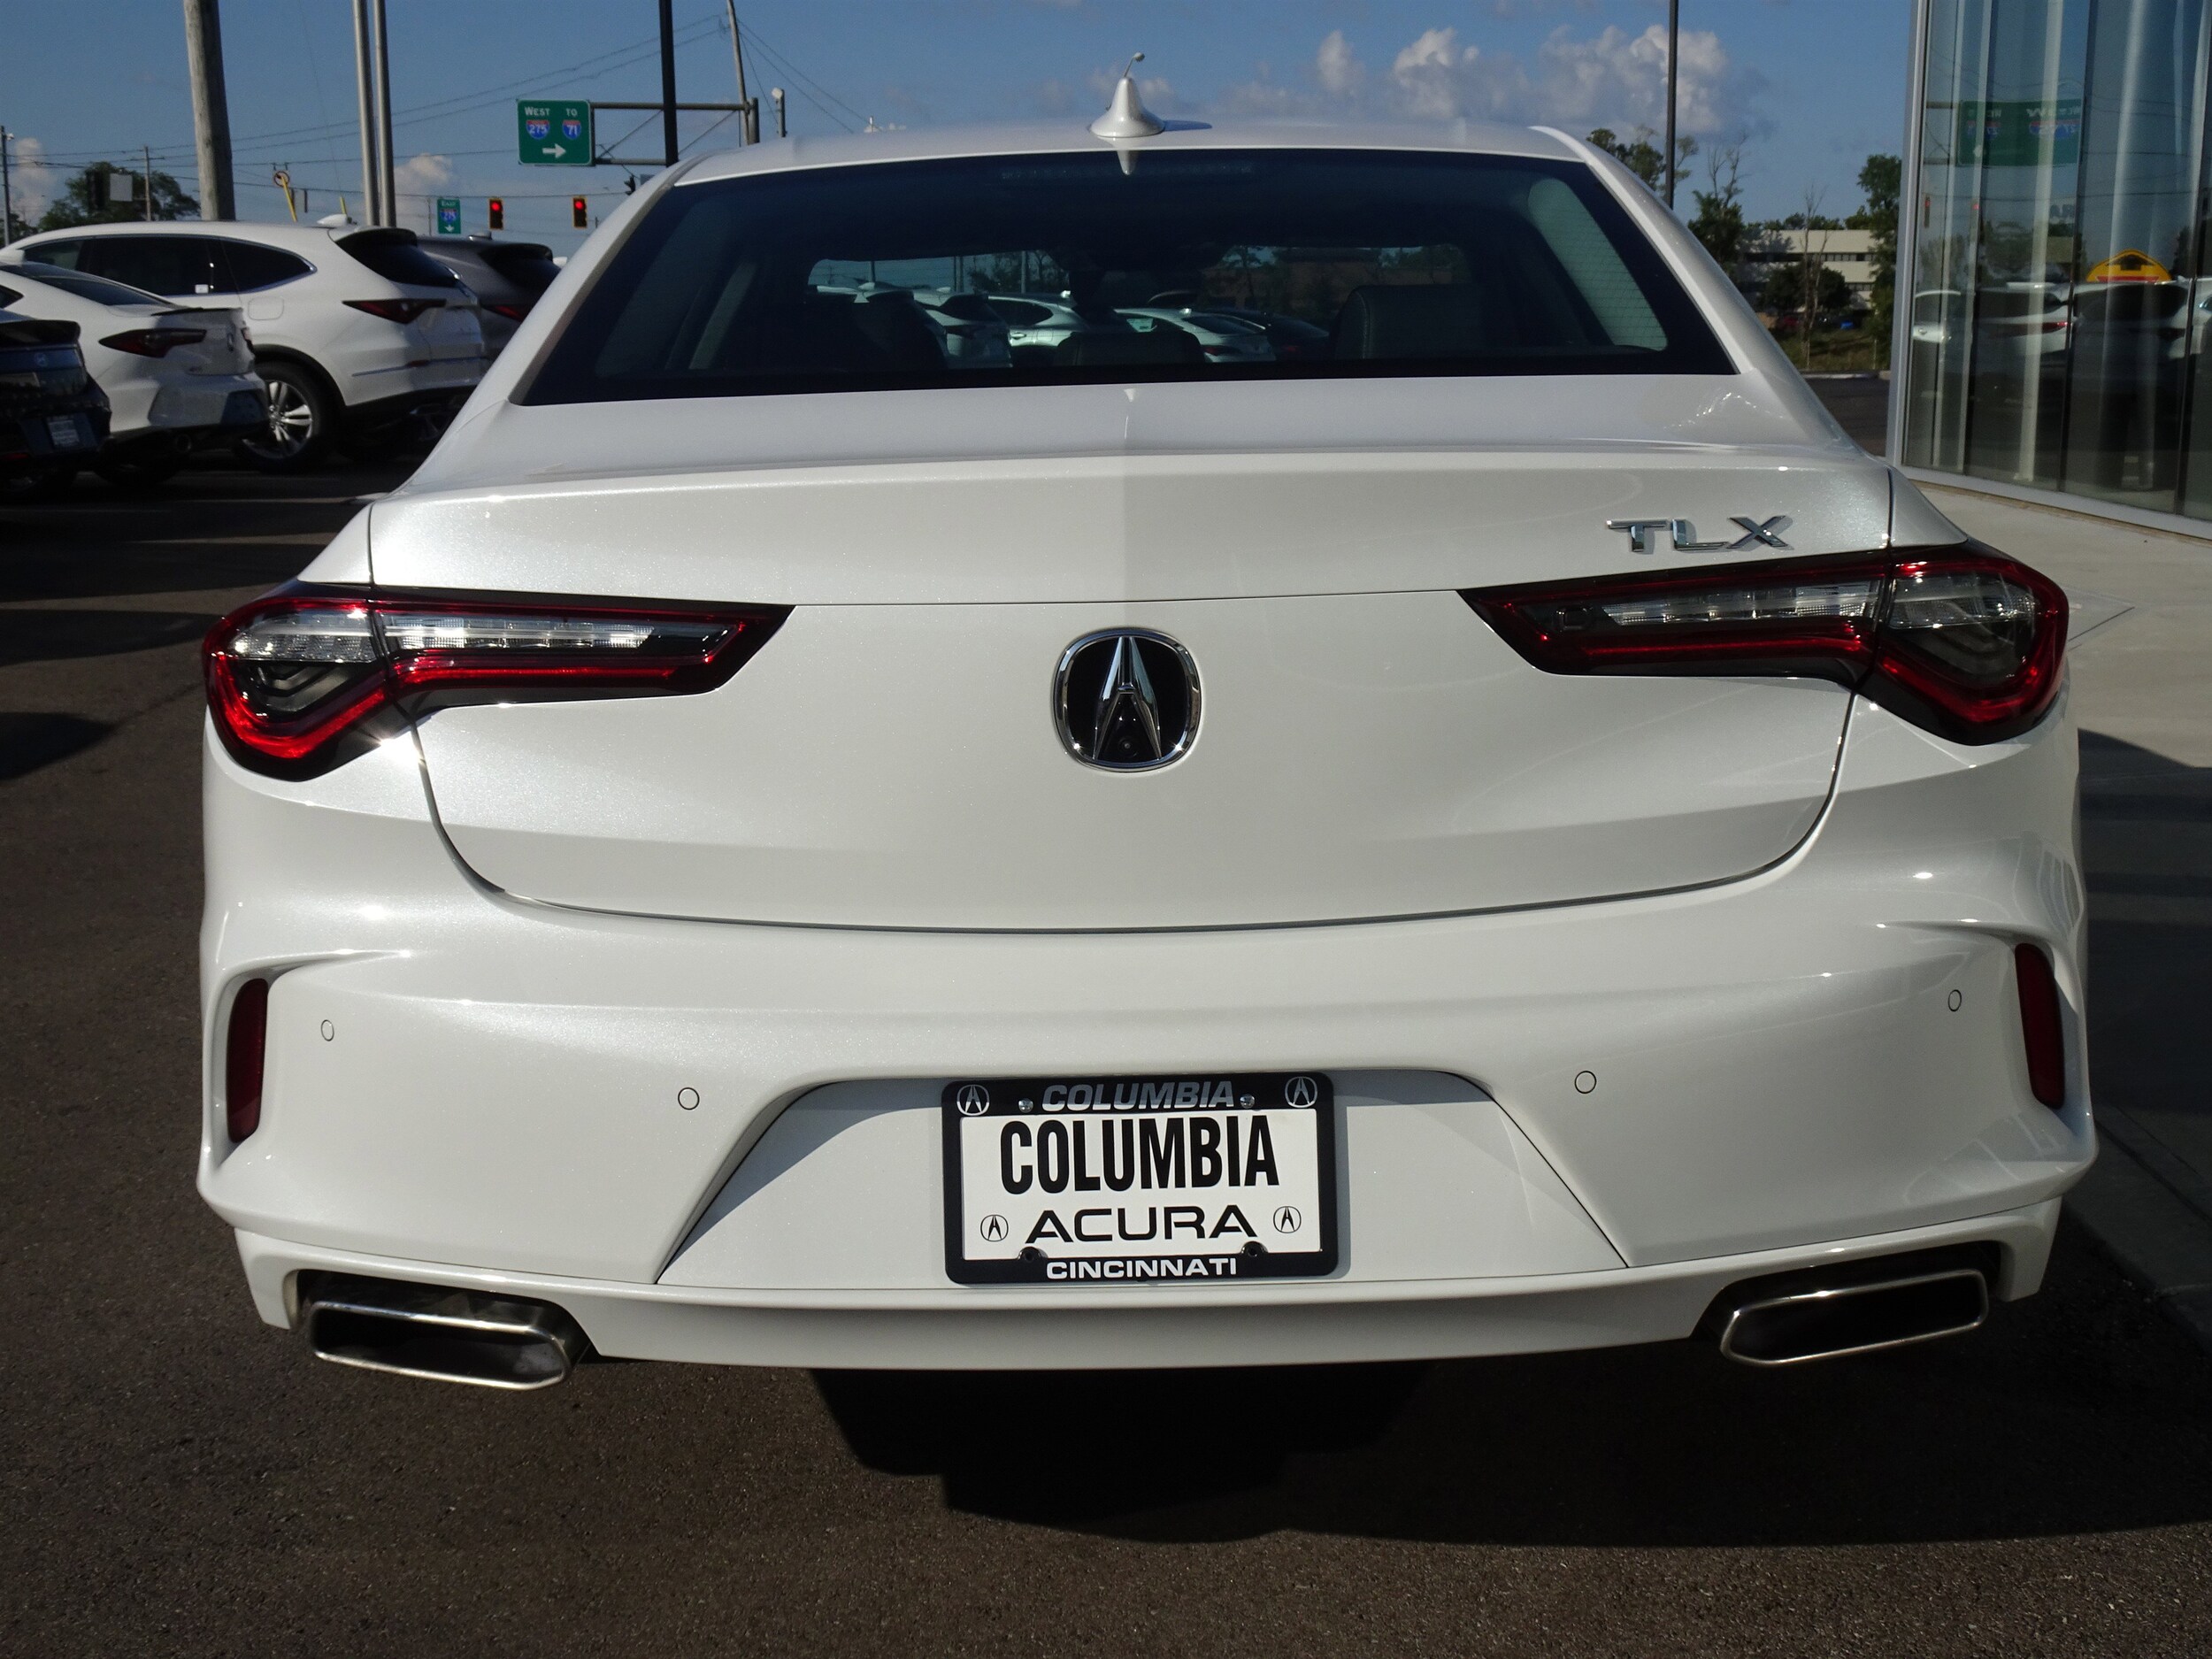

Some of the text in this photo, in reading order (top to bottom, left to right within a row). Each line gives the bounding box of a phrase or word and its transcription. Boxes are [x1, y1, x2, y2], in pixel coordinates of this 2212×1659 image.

[525, 107, 549, 116] WEST
[529, 125, 578, 135] 275 71
[1606, 515, 1789, 552] TLX
[1041, 1080, 1234, 1112] COLUMBIA
[1000, 1115, 1279, 1194] COLUMBIA
[1025, 1205, 1258, 1244] ACURA
[1047, 1257, 1237, 1280] CINCINNATI
